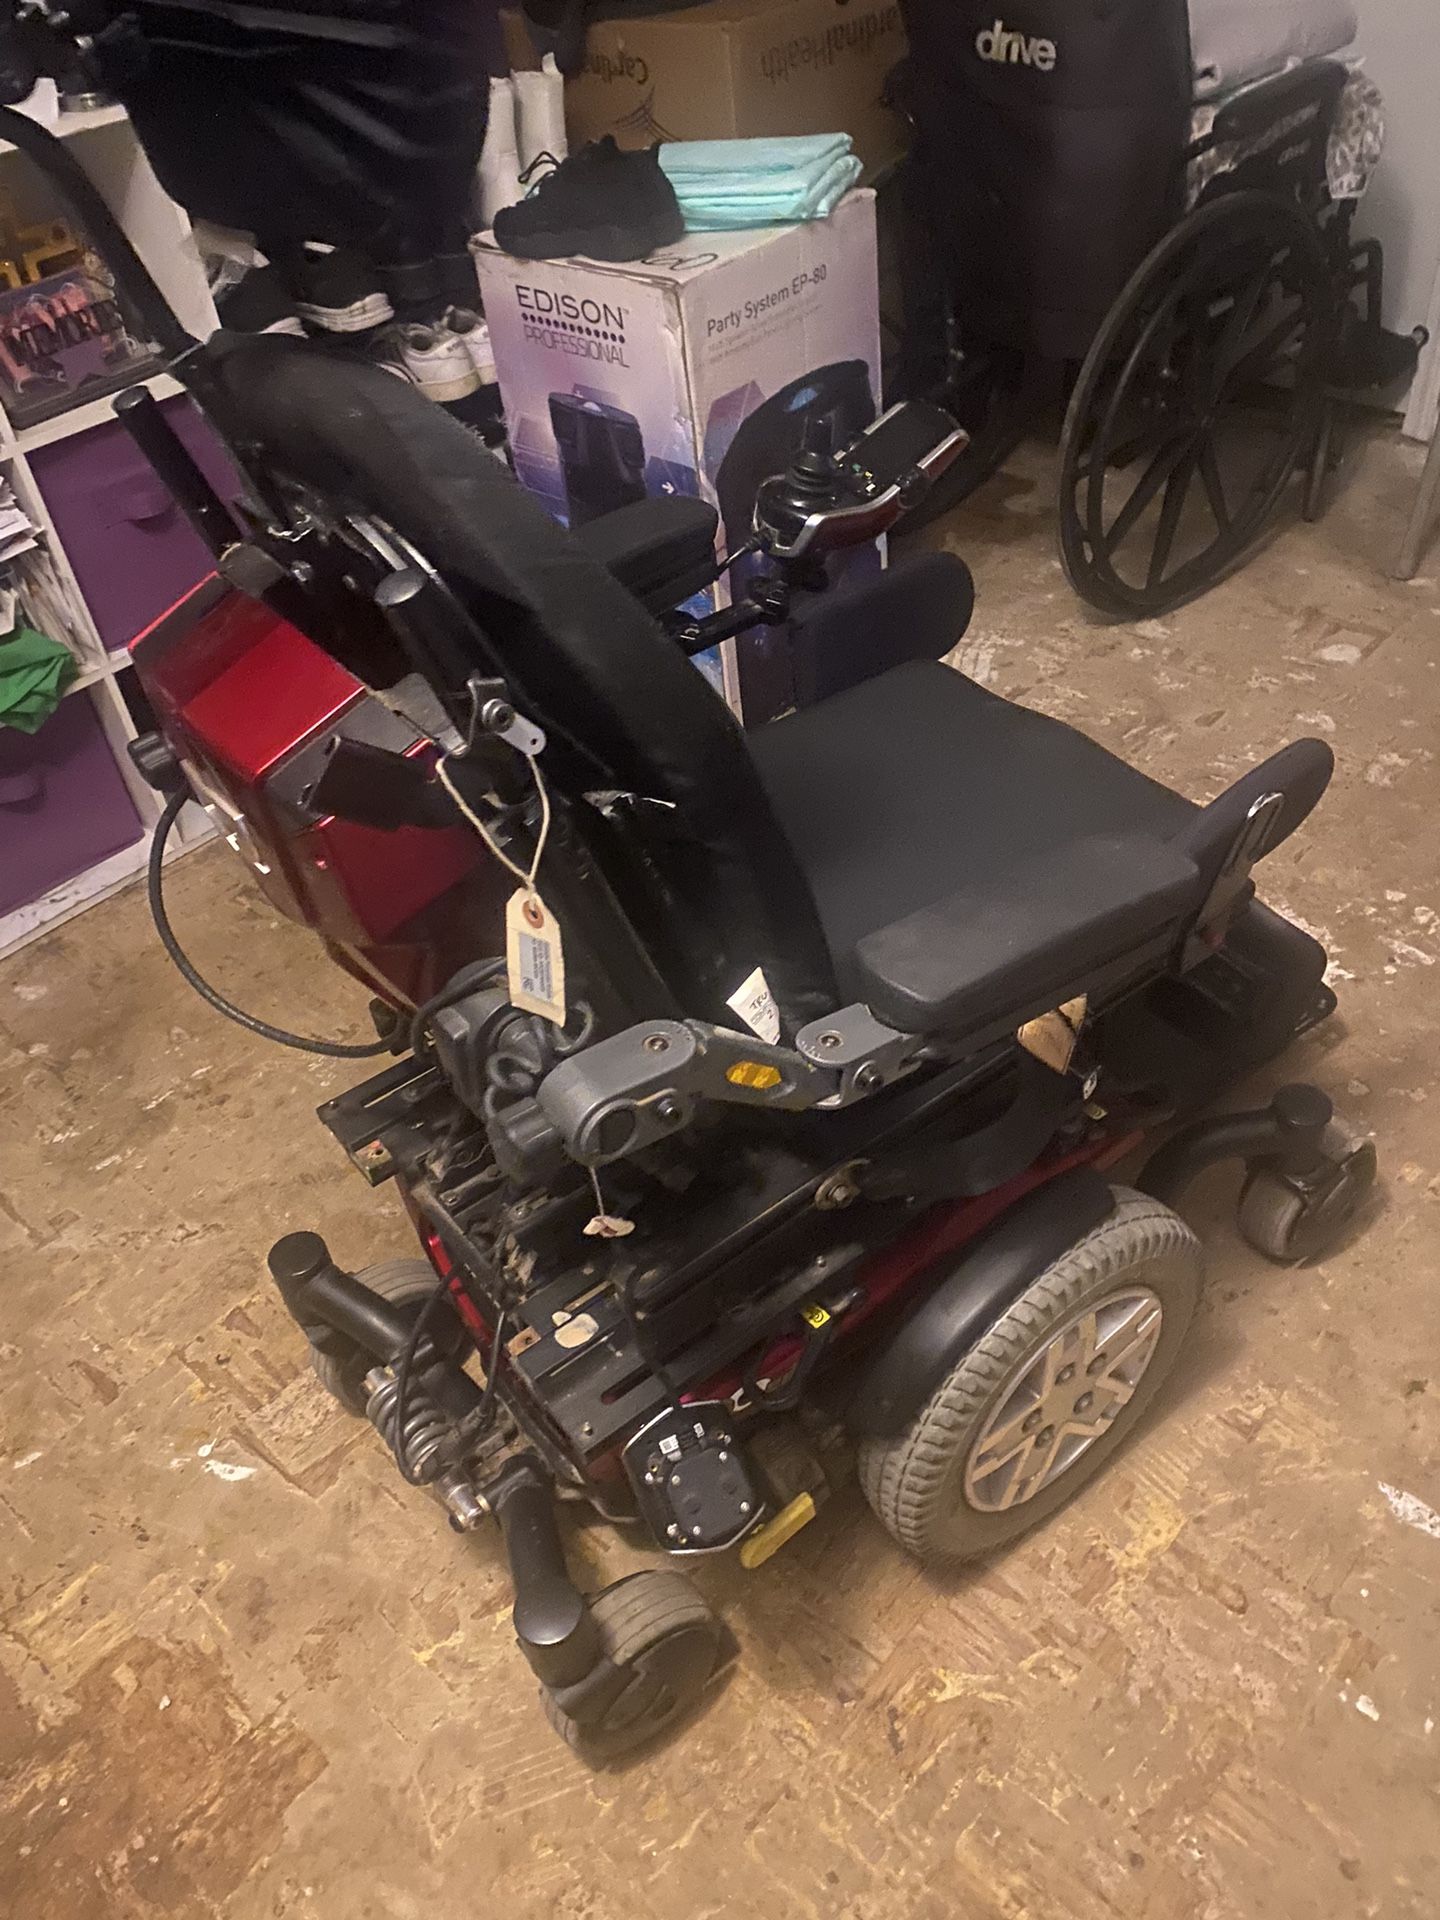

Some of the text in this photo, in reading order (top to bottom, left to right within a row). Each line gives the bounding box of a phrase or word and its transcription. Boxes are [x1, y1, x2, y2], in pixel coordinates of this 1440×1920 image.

[976, 19, 1056, 71] drive
[515, 284, 624, 330] EDISON
[707, 310, 742, 337] Party
[744, 287, 789, 319] System
[792, 264, 827, 295] EP-80
[523, 323, 630, 368] PROFESSIONAL
